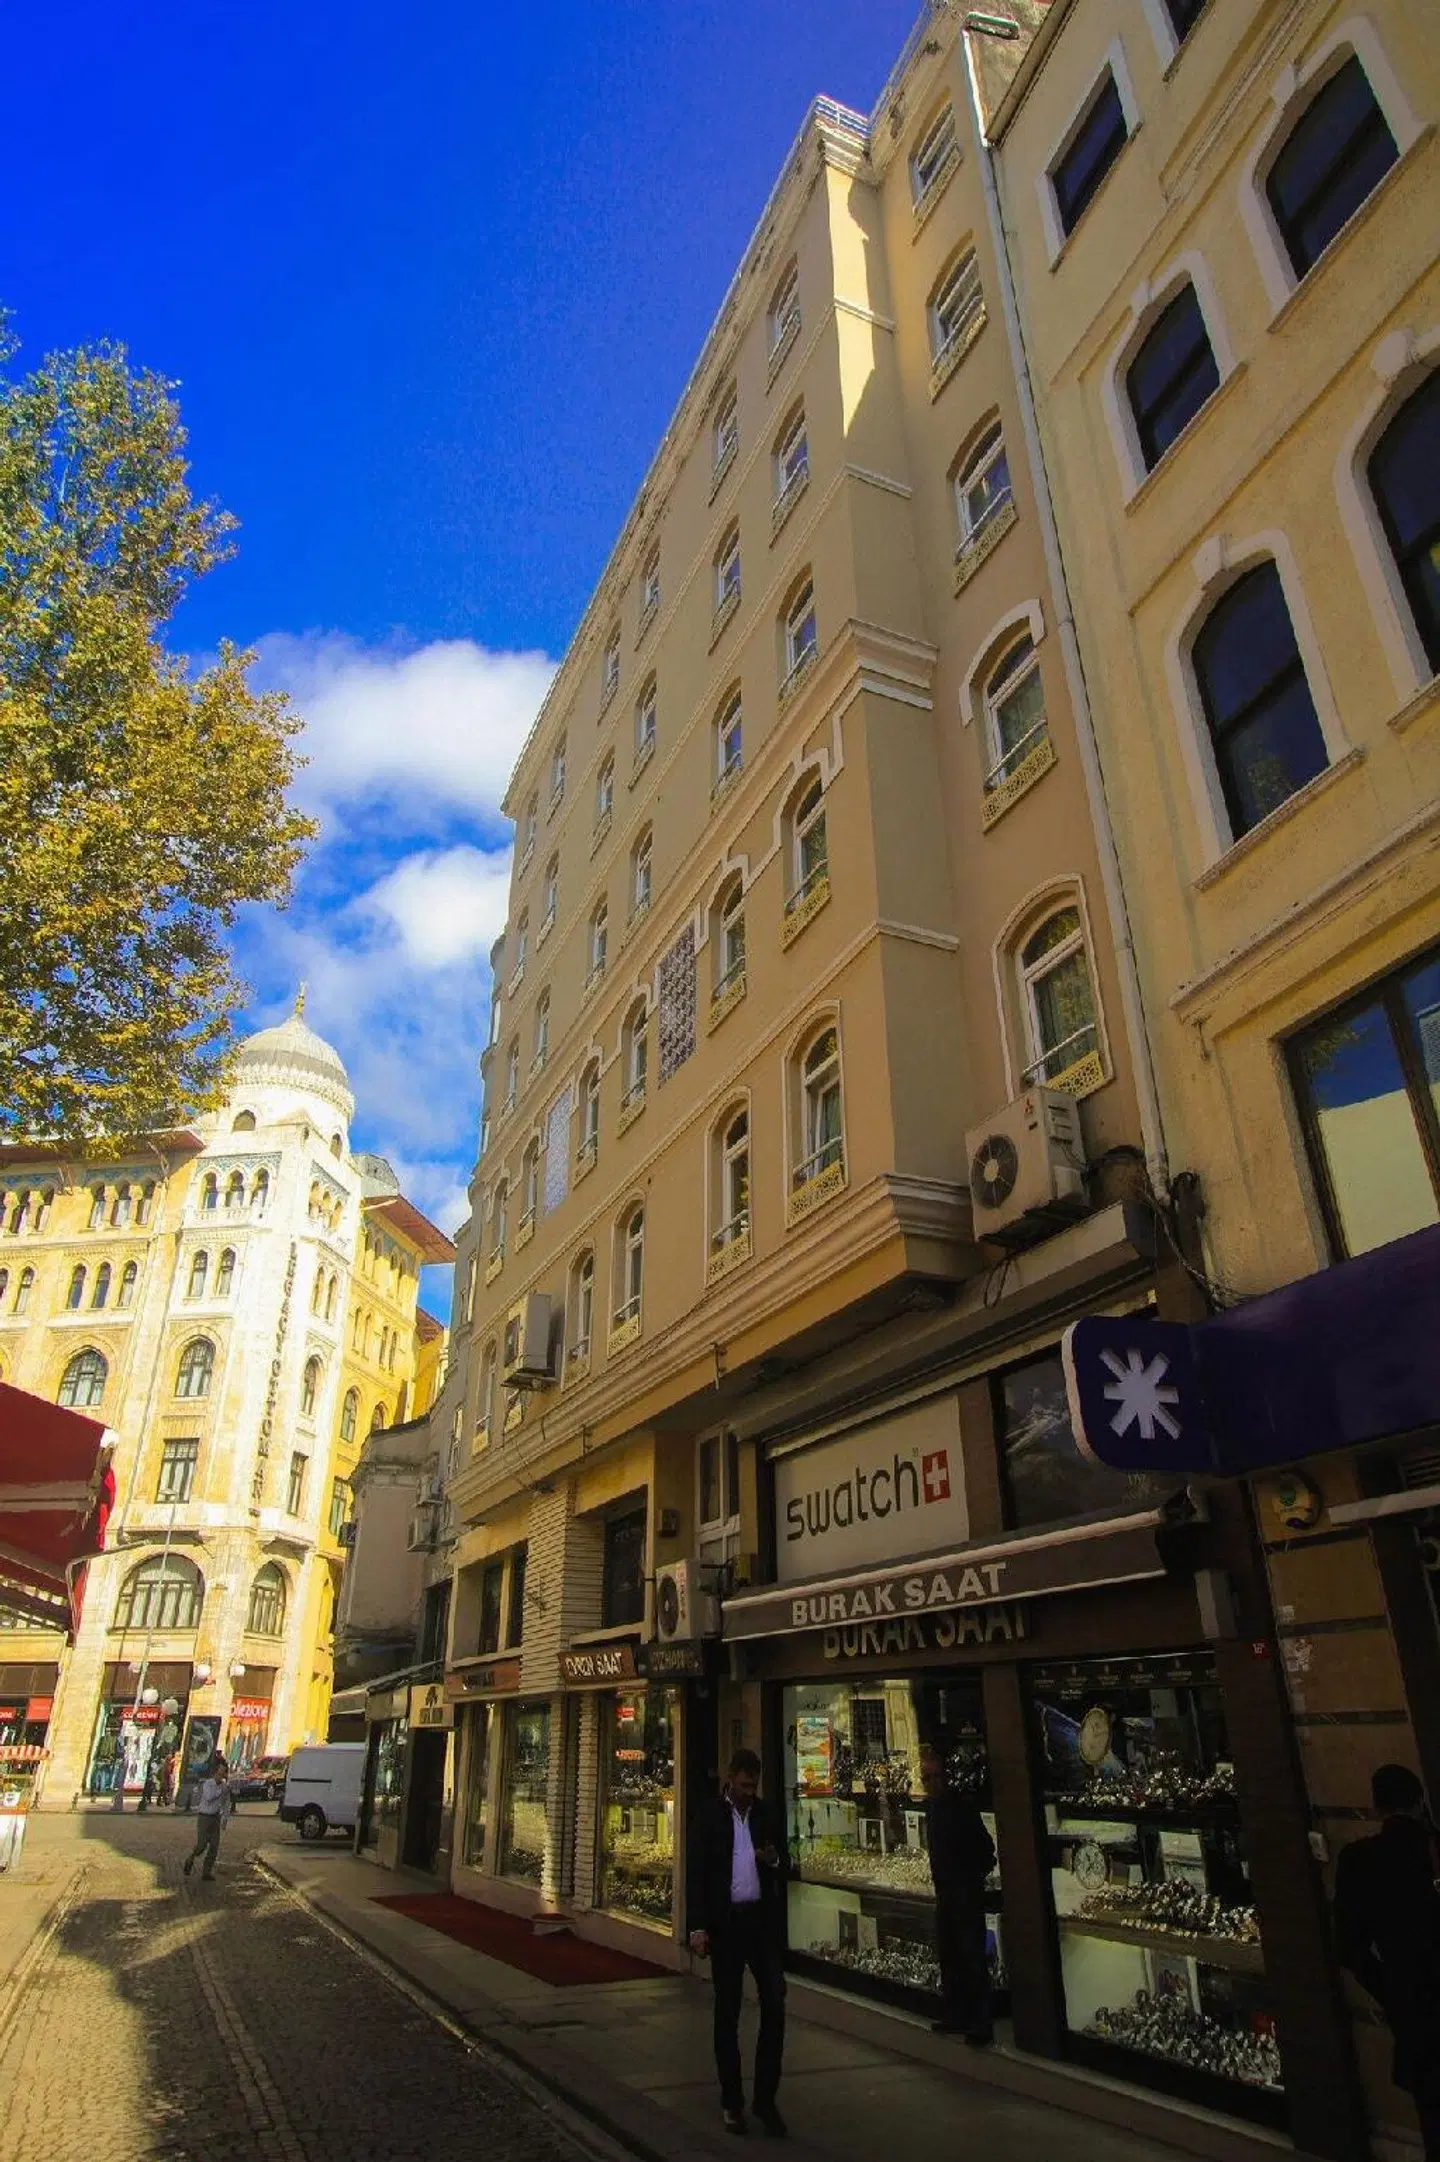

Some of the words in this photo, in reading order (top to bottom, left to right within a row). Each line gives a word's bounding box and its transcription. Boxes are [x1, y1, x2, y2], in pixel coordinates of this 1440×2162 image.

[787, 1454, 919, 1541] swatch
[792, 1583, 896, 1626] BURAK
[904, 1562, 1006, 1607] SAAT
